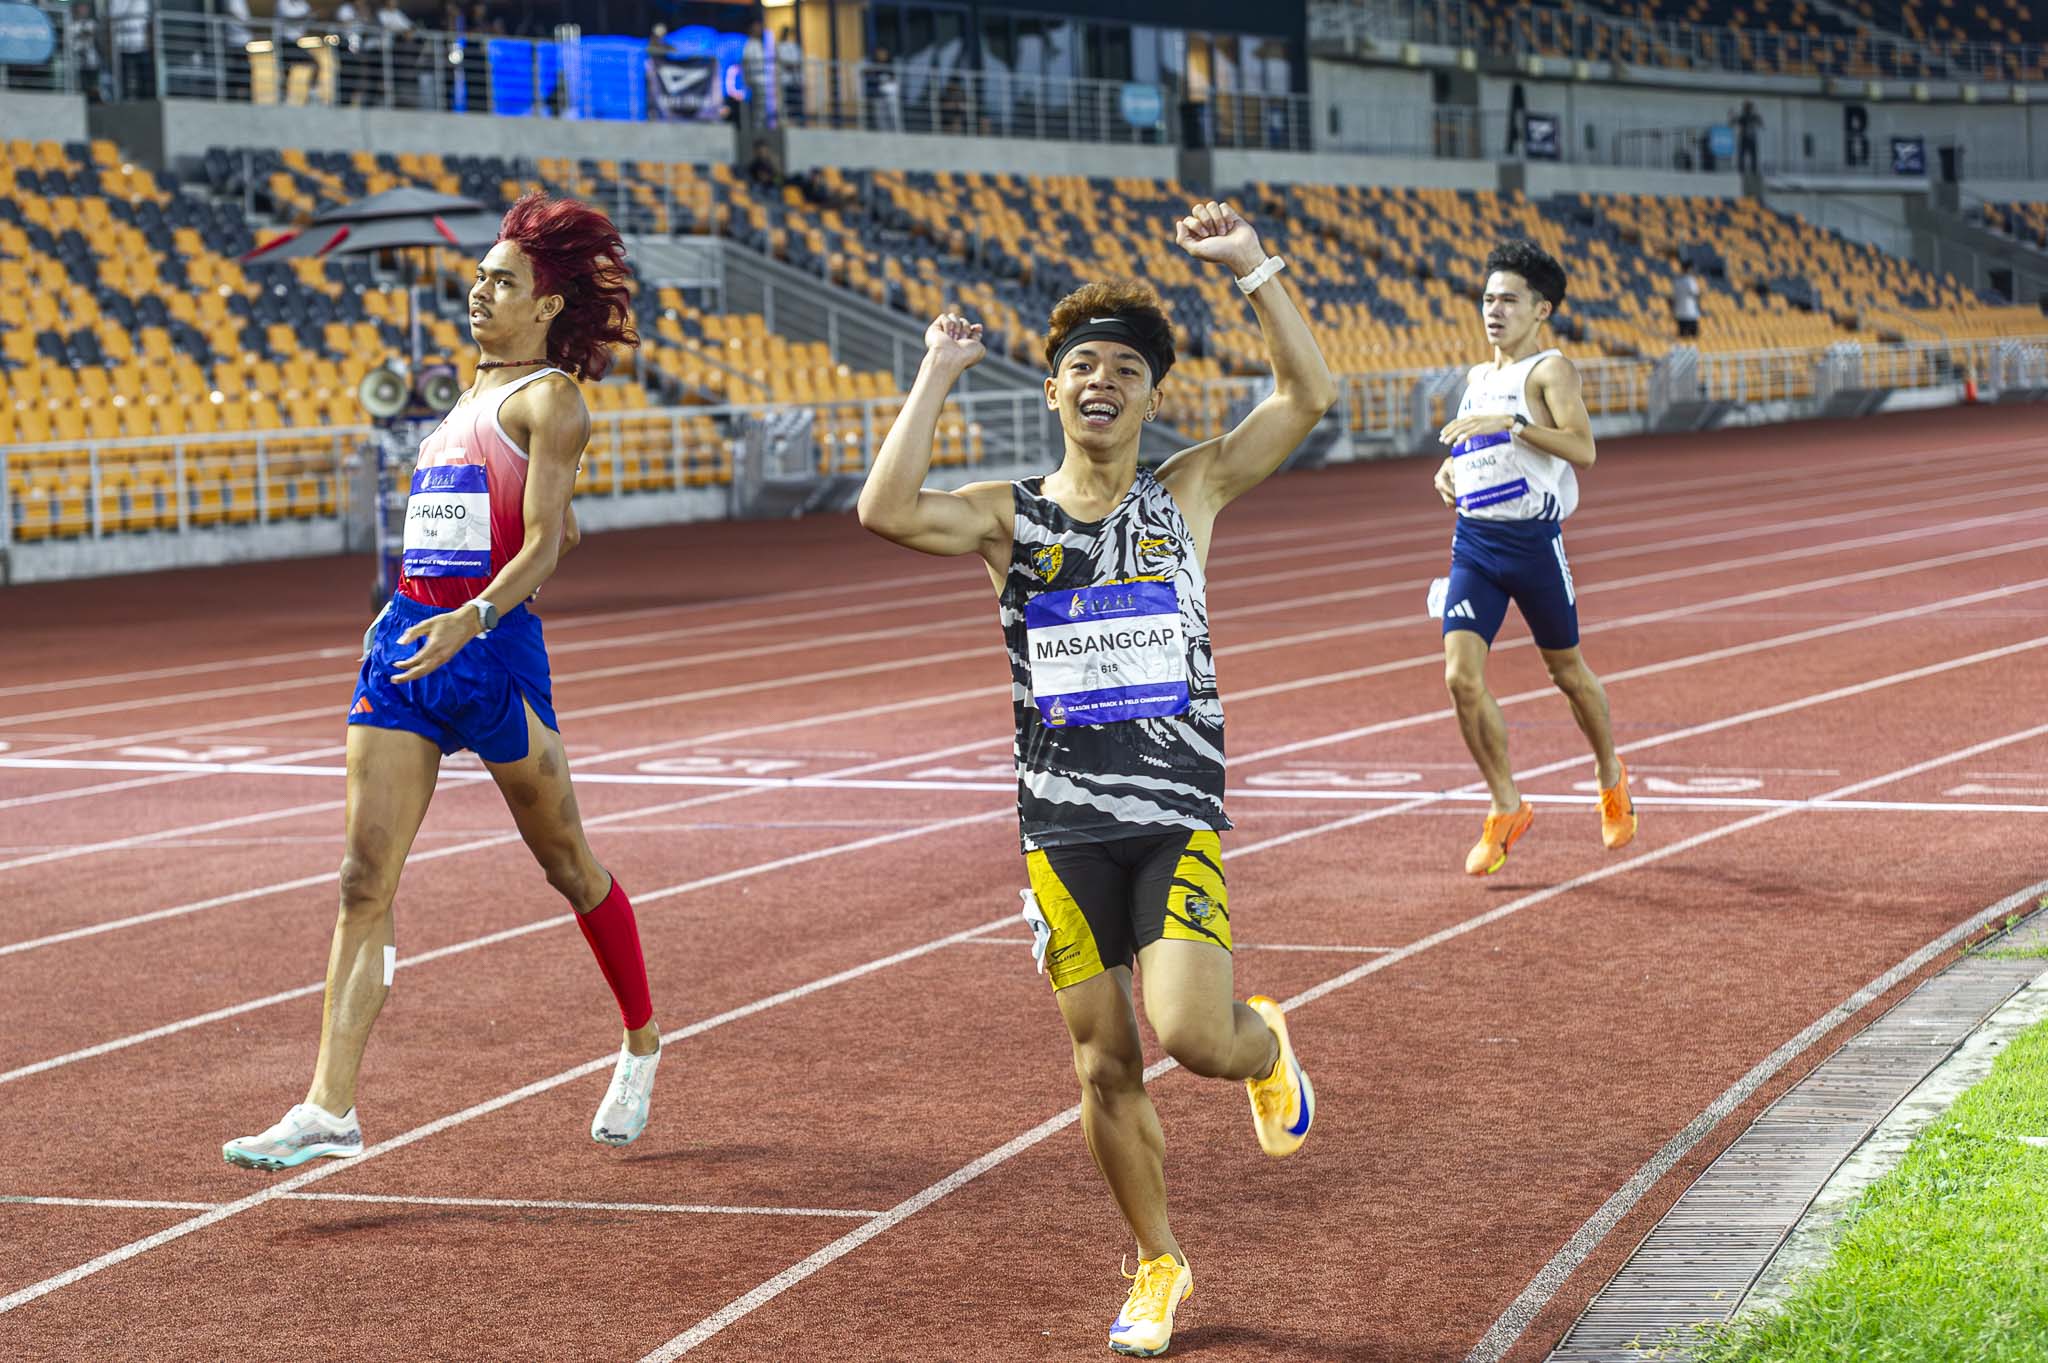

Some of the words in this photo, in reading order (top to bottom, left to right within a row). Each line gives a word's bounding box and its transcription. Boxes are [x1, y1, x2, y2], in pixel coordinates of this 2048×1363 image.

[1036, 628, 1175, 660] MASANGCAP
[1101, 663, 1118, 674] 615
[1068, 704, 1090, 712] SEASON
